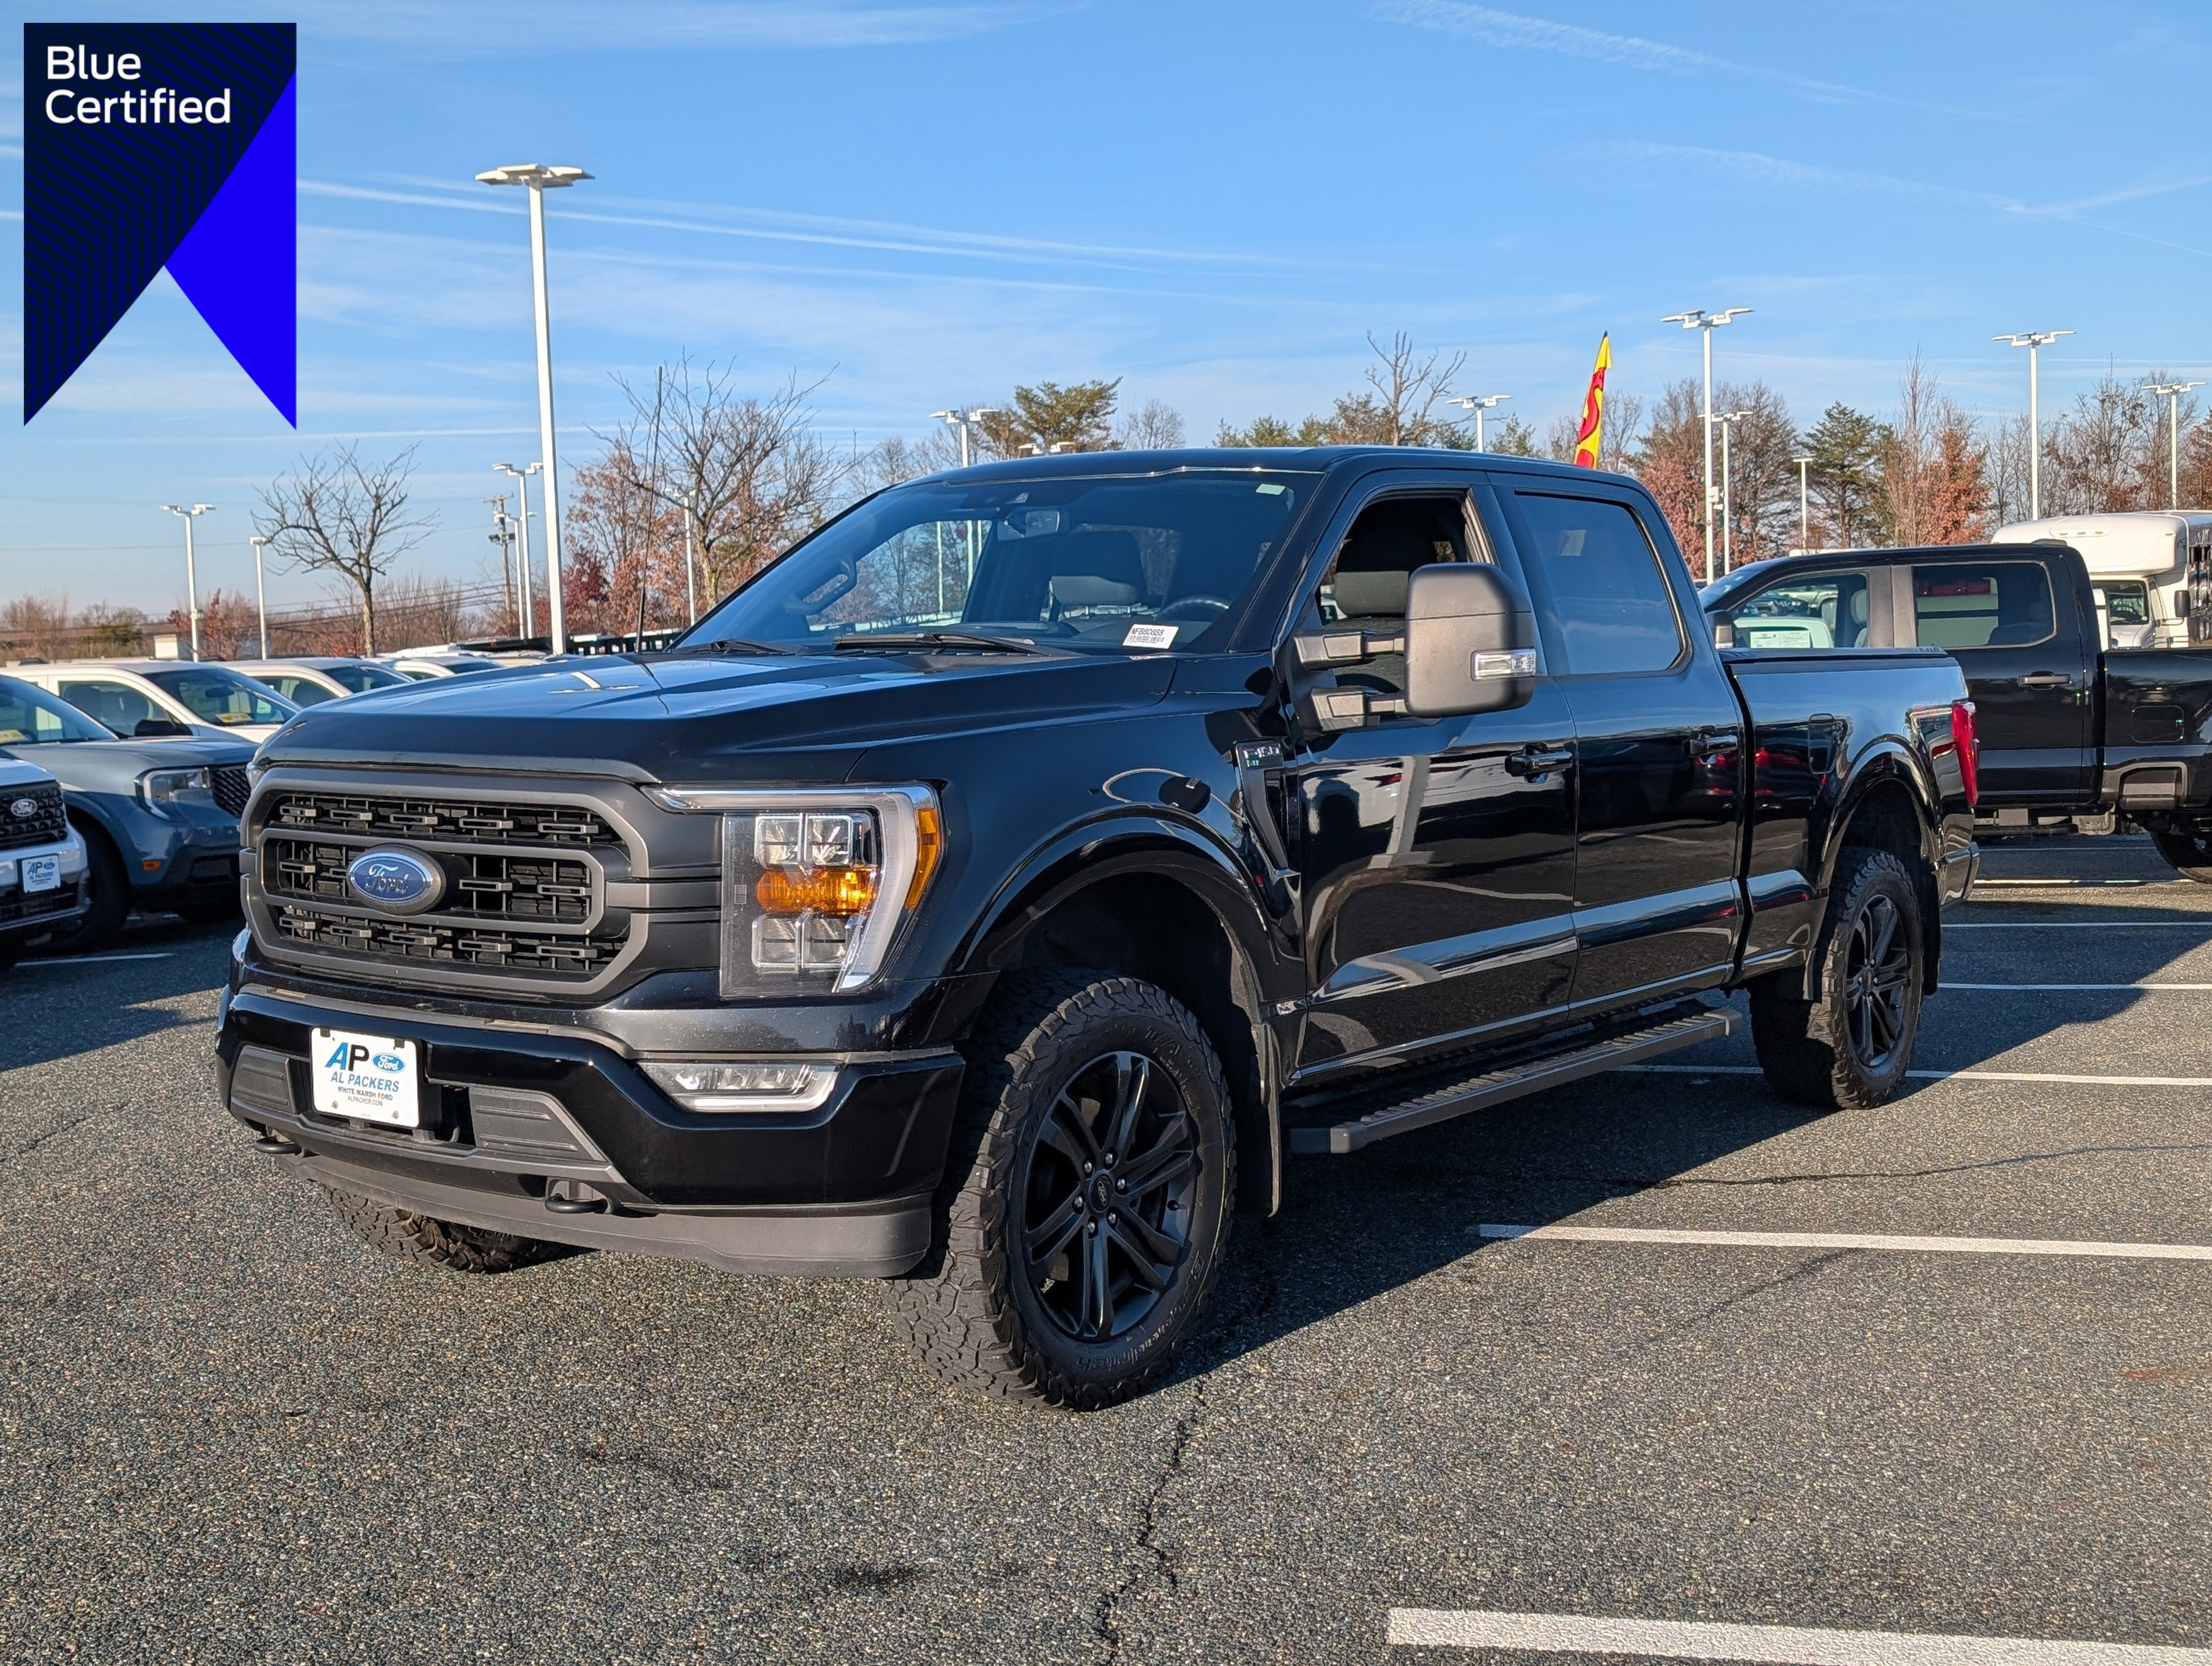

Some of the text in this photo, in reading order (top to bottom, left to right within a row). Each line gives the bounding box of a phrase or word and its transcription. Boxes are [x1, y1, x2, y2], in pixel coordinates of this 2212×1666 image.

[28, 862, 43, 874] AP
[365, 863, 409, 894] Ford
[325, 1042, 400, 1072] AP Ford
[331, 1072, 400, 1092] AL PACKERS
